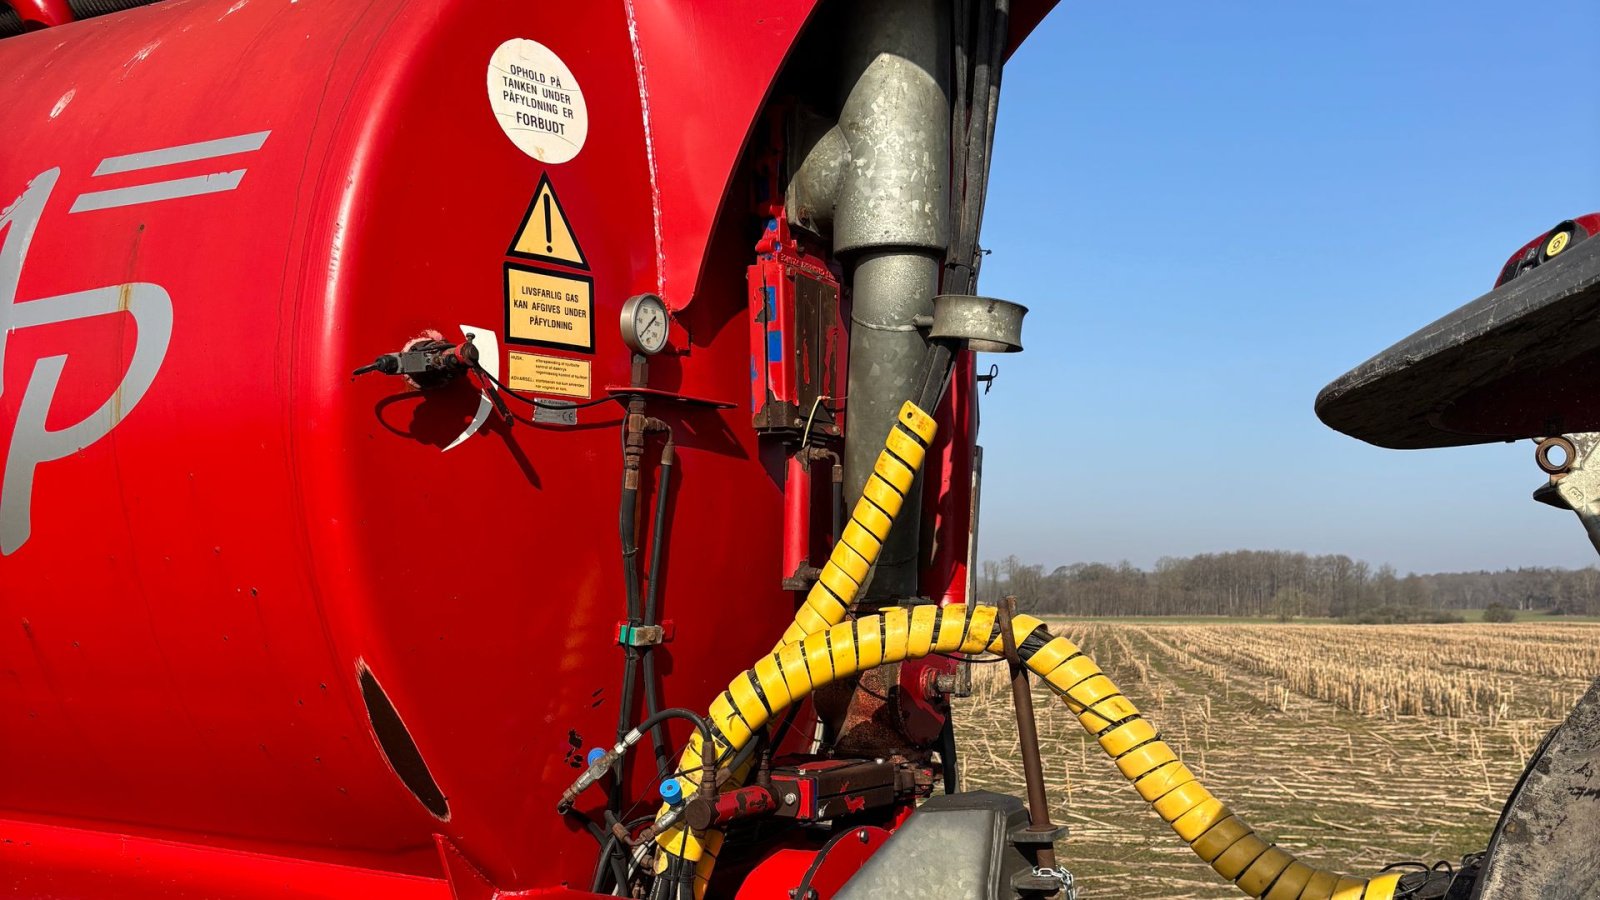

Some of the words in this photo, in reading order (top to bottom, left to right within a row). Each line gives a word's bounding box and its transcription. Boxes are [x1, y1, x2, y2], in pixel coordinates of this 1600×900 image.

[510, 64, 545, 83] OPHOLD
[550, 76, 562, 89] PÅ
[502, 76, 538, 95] TANKEN
[542, 88, 571, 105] UNDER
[503, 90, 558, 115] PÅFYLDNING
[563, 107, 574, 119] ER
[516, 111, 565, 136] FORBUDT
[521, 285, 562, 300] LIVSFARLIG
[565, 293, 579, 303] GAS
[513, 299, 528, 309] KAN
[531, 302, 561, 314] AFGIVES
[564, 307, 587, 318] UNDER
[529, 315, 573, 331] PÅFYLDNING
